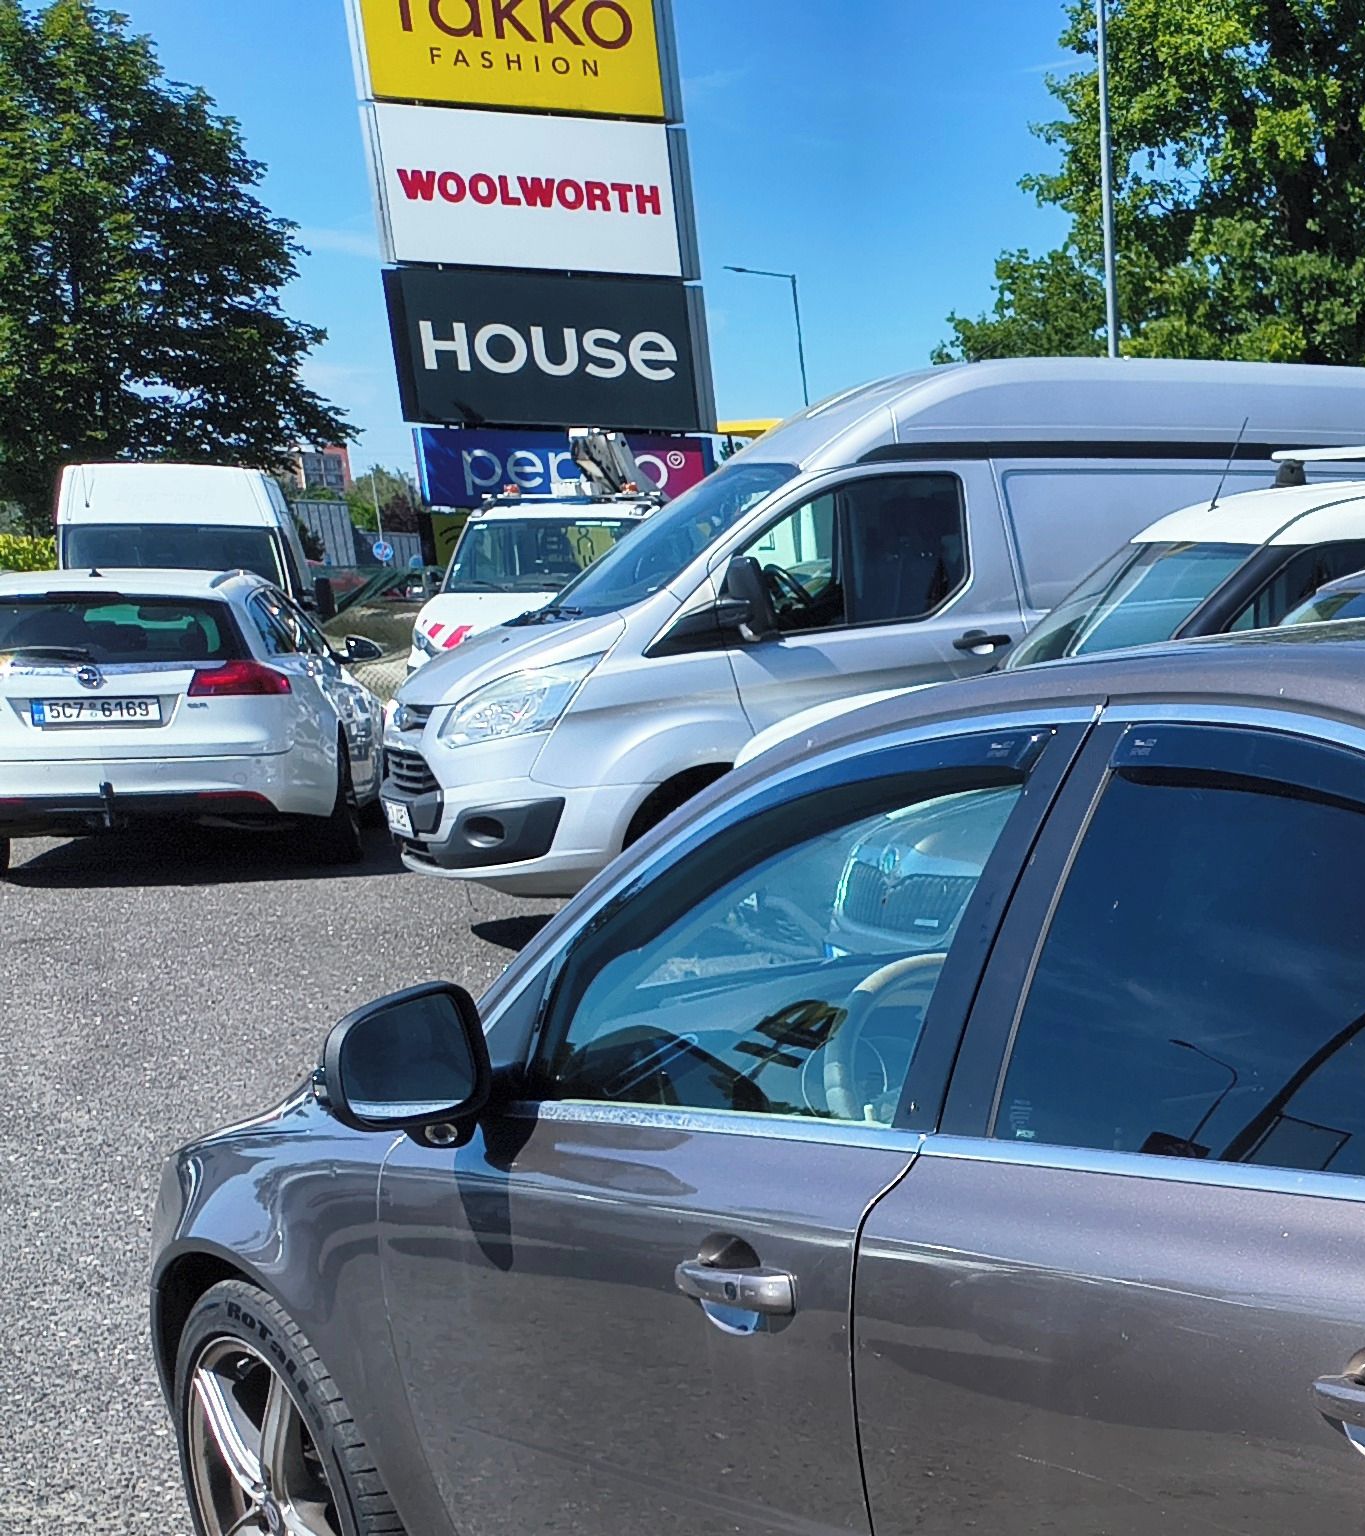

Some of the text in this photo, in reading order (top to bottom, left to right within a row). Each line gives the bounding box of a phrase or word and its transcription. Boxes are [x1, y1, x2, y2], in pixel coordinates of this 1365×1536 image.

[429, 47, 600, 77] FASHION
[396, 168, 661, 215] WOOLWORTH
[462, 449, 668, 496] pepo
[49, 702, 84, 719] 5C7
[101, 701, 150, 718] 6169
